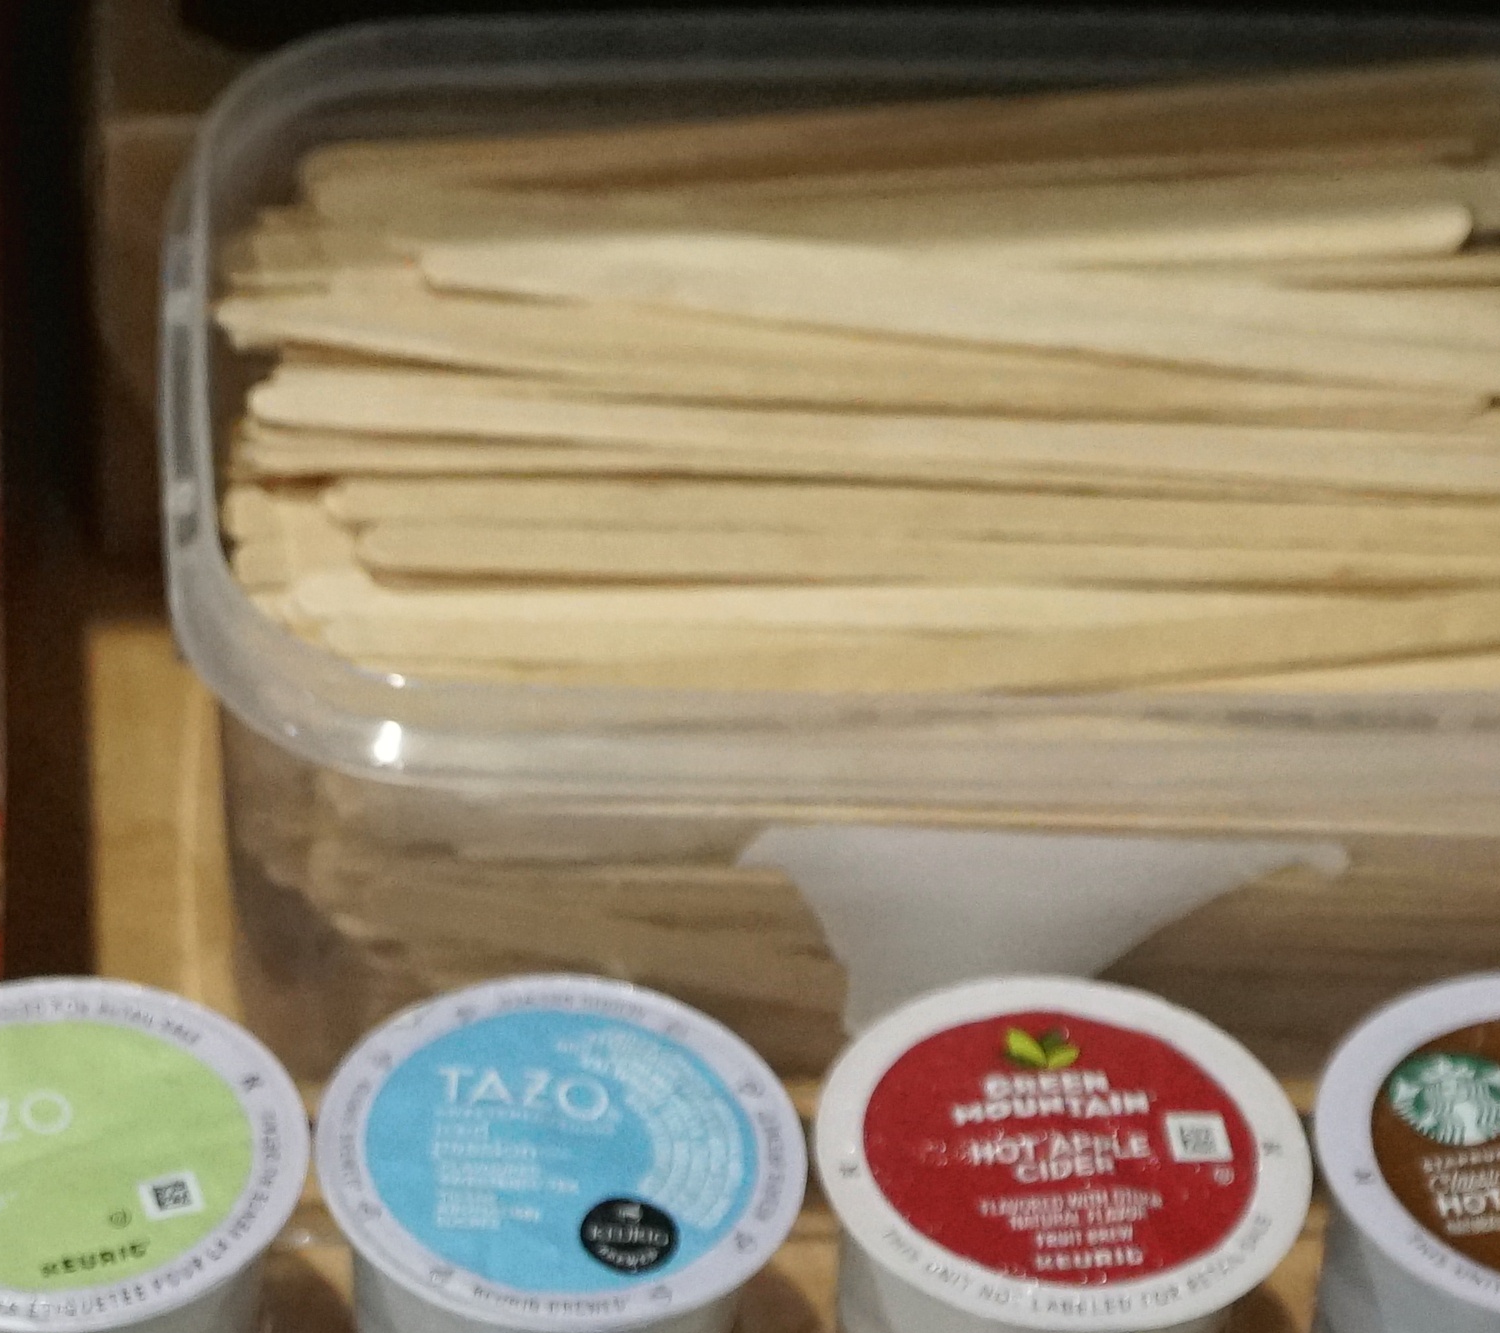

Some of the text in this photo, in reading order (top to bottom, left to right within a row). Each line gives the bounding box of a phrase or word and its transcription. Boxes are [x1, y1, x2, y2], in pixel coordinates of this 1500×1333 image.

[950, 1090, 1151, 1126] MOUNTAIN
[967, 1130, 1151, 1166] HOT APPLE
[1010, 1152, 1115, 1182] CIDER
